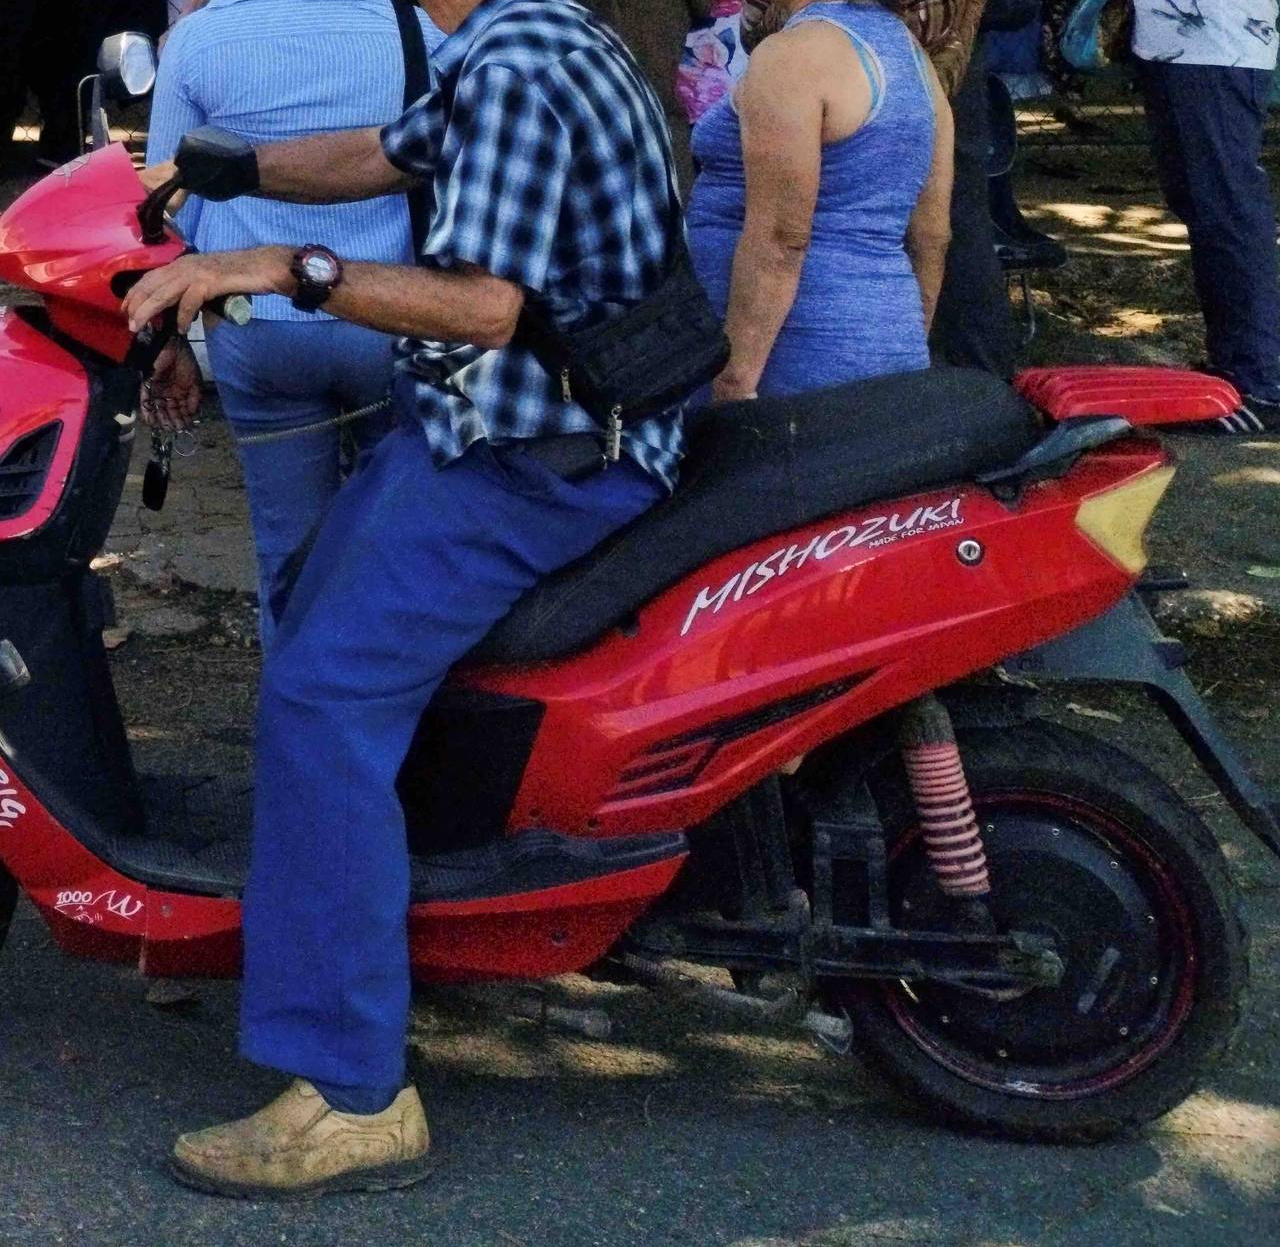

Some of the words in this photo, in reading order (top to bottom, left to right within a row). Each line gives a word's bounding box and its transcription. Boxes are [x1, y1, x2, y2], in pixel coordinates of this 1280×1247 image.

[869, 533, 898, 549] MADE
[901, 526, 926, 539] FOR
[680, 498, 962, 636] MISHOZUKI
[56, 890, 92, 905] 1000
